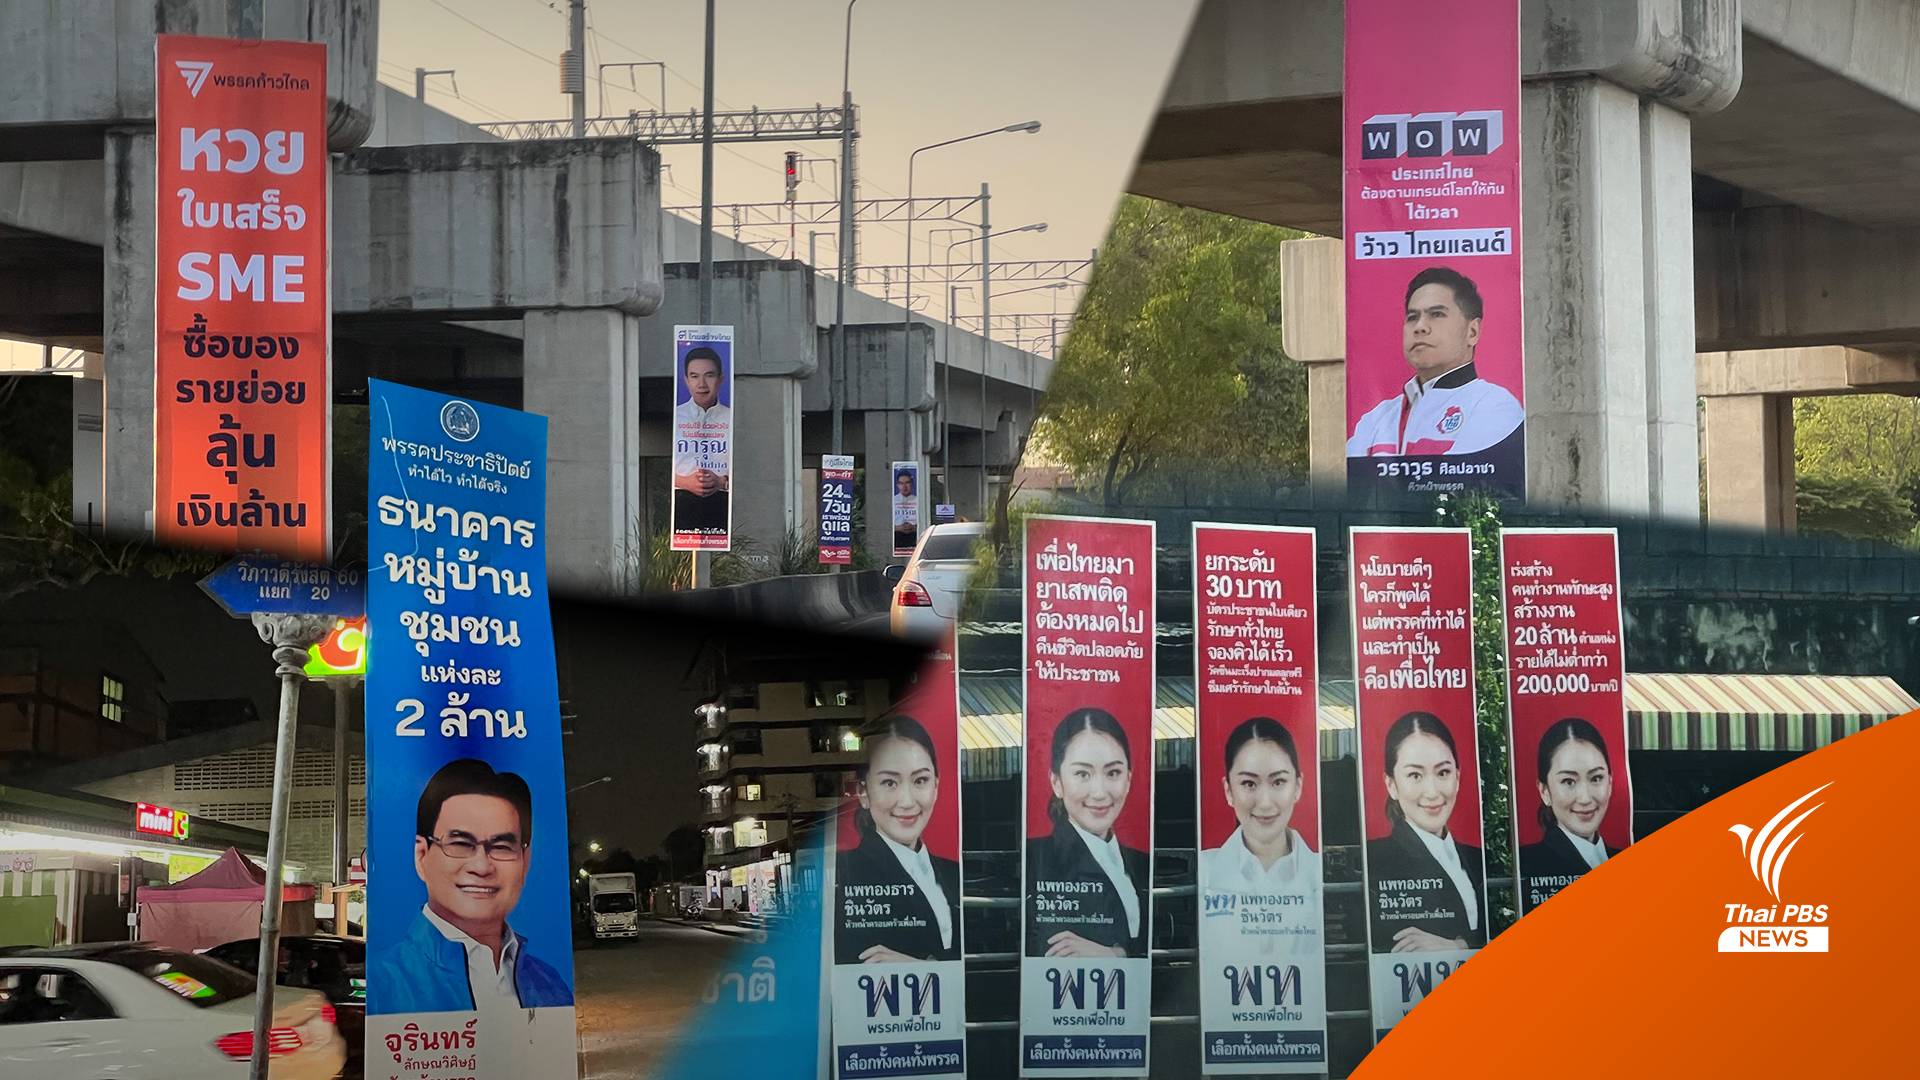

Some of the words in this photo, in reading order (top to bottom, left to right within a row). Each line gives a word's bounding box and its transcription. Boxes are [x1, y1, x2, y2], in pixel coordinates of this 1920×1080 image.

[213, 72, 310, 91] พรรคก้าวไกล
[1368, 128, 1481, 150] WOW
[180, 127, 305, 175] หวย
[1392, 162, 1473, 181] ประเทศไทย
[1361, 181, 1505, 199] ต้องตามเทรนด์โลกให้ทัน
[177, 187, 306, 230] ใบเสร็จ
[1405, 203, 1458, 220] ได้เวลา
[1363, 236, 1399, 256] ว้าว
[1405, 230, 1505, 255] ไทยแลนด์
[177, 251, 305, 302] SME
[183, 313, 299, 359] ซื้อของ
[176, 369, 306, 404] รายย่อย
[206, 413, 275, 484] ลุ้น
[382, 437, 532, 479] พรรคประชาธิปัตย์
[678, 440, 727, 460] การุณ
[408, 463, 452, 484] ทำได้ไว
[456, 473, 507, 494] ทำได้จริง
[1440, 462, 1495, 476] ศิลปอาชา
[822, 483, 844, 498] 24
[176, 489, 306, 527] เงินล้าน
[378, 495, 535, 548] ธนาคาร
[821, 521, 850, 536] ดูแล
[1036, 538, 1135, 575] เพื่อไทยมา
[1205, 549, 1275, 573] ยกระดับ
[1360, 555, 1433, 580] นโยบายดีๆ
[384, 547, 532, 605] หมู่บ้าน
[1510, 560, 1552, 577] เร่งสร้าง
[259, 585, 291, 600] แยก
[310, 586, 330, 601] 20
[1036, 577, 1128, 602] ยาเสพติด
[1206, 575, 1233, 597] 30
[1236, 579, 1281, 599] บาท
[1360, 581, 1431, 609] ใครก็พูดได้
[1512, 579, 1613, 600] คนทำงานทักษะสูง
[1035, 601, 1144, 633] ต้องหมดไป
[1206, 602, 1308, 618] บัตรประชาชนใบเดียว
[1362, 605, 1466, 630] แต่พรรคที่ทำได้
[1514, 598, 1575, 619] สร้างงาน
[400, 611, 521, 657] ชุมชน
[1206, 618, 1284, 639] รักษาทั่วไทย
[1514, 626, 1538, 646] 20
[1539, 622, 1577, 646] ล้าน
[1035, 636, 1144, 659] คืนชีวิตปลอดภัย
[1363, 632, 1440, 655] และทำเป็น
[1515, 646, 1608, 669] รายได้ไม่ต่ำกว่า
[421, 659, 501, 685] แห่งละ
[1035, 660, 1120, 683] ให้ประชาชน
[1517, 673, 1589, 696] 200,000
[395, 698, 426, 737] 2
[440, 691, 527, 738] ล้าน
[140, 807, 173, 832] mini
[844, 882, 915, 897] แพทองธาร
[1036, 880, 1104, 893] แพทองธาร
[1378, 878, 1443, 891] แพทองธาร
[844, 899, 891, 917] ชินวัตร
[1036, 894, 1080, 911] ชินวัตร
[1240, 893, 1304, 906] แพทองธาร
[1378, 892, 1423, 909] ชินวัตร
[1240, 908, 1283, 924] ชินวัตร
[858, 972, 941, 1017] พท
[1045, 967, 1125, 1010] พท
[1223, 965, 1302, 1006] พท
[867, 1016, 941, 1034] พรรคเพื่อไทย
[1052, 1010, 1125, 1026] พรรคเพื่อไทย
[1232, 1006, 1303, 1022] พรรคเพื่อไทย
[384, 1019, 478, 1063] จุรินทร์
[1030, 1037, 1142, 1060] เลือกทั้งคนทั้งพรรค
[1211, 1032, 1320, 1056] เลือกทั้งคนทั้งพรรค
[845, 1044, 960, 1071] เลือกทั้งคนทั้งพรรค
